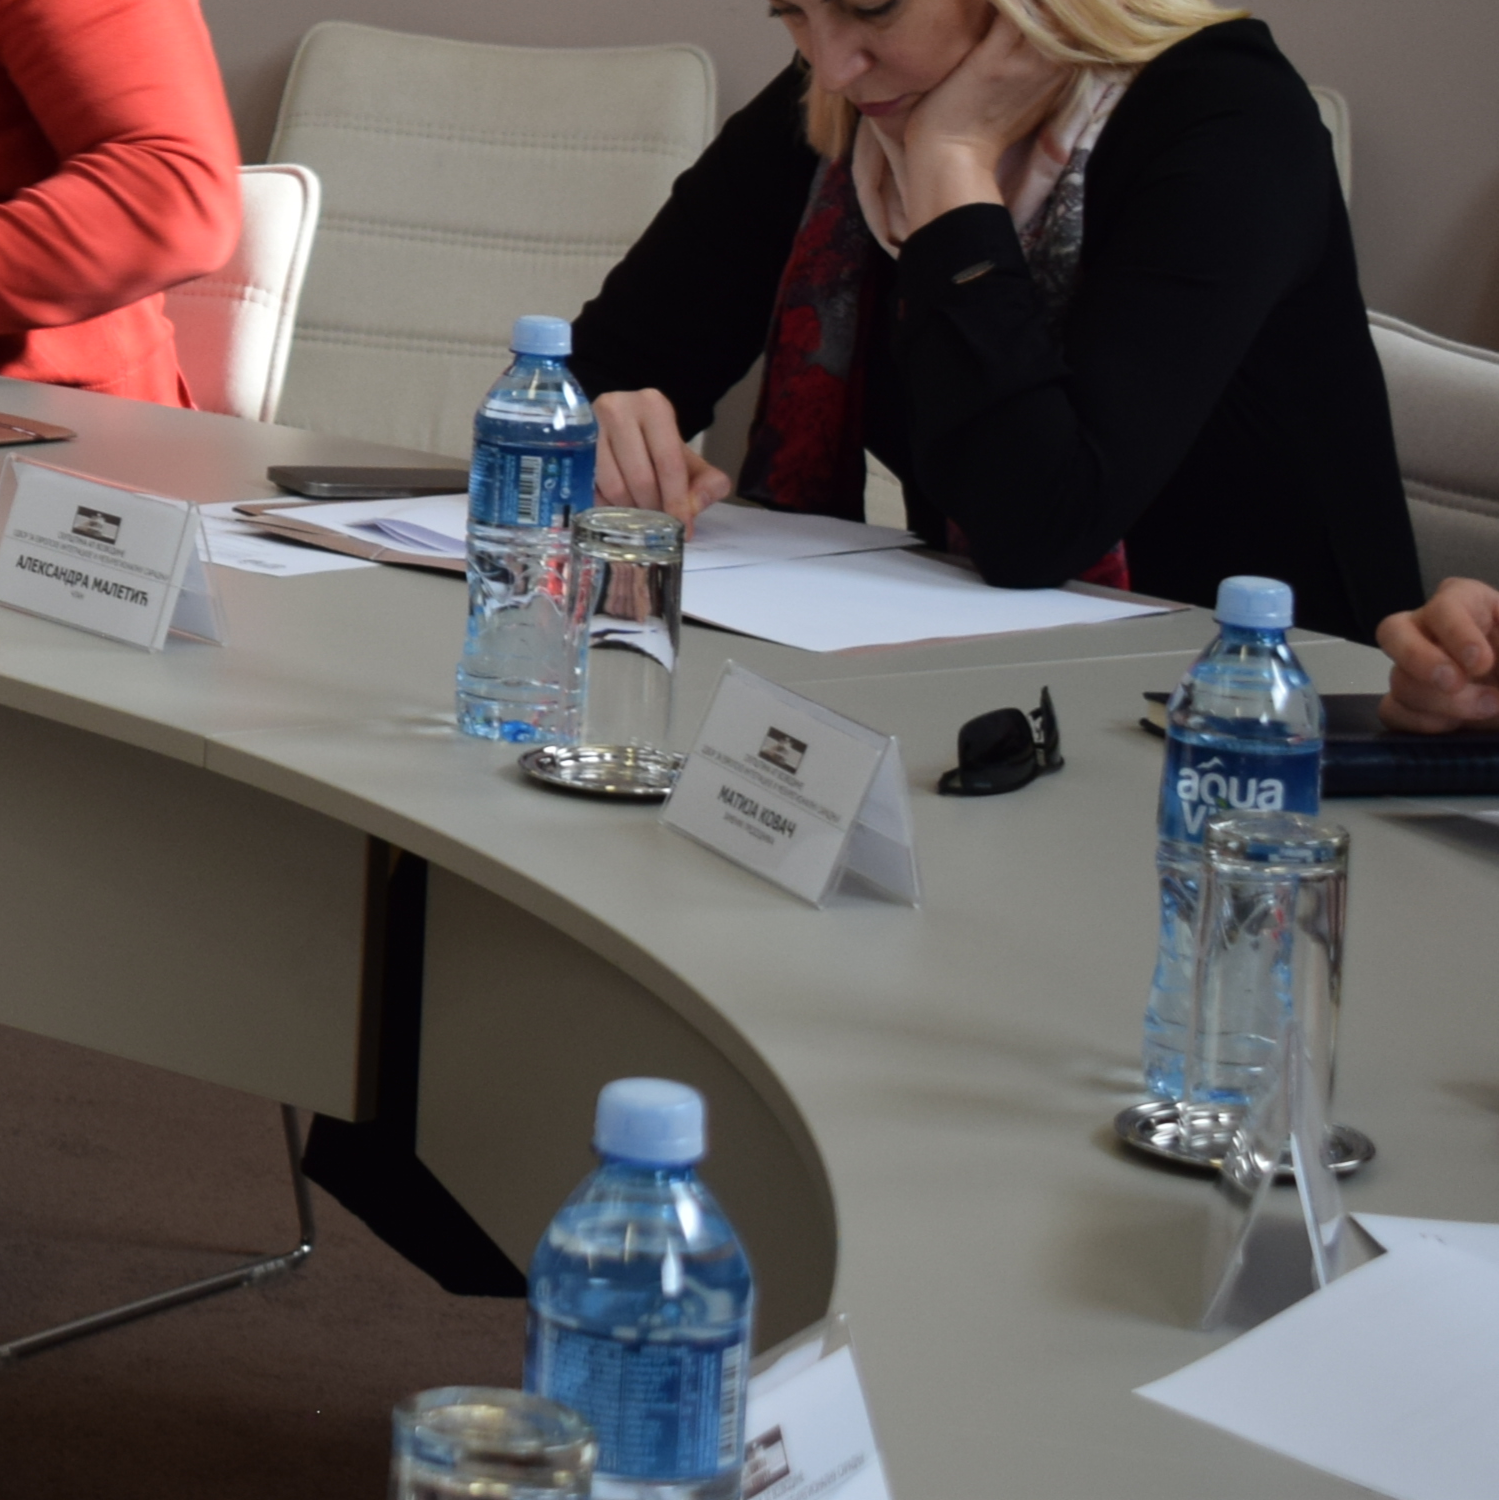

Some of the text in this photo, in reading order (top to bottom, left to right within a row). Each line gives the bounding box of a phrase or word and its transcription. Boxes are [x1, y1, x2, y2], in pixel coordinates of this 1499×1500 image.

[15, 554, 90, 590] АЛЕКСАНДРА
[91, 576, 149, 607] МАЛЕТИЋ
[759, 804, 797, 839] КОВАЧ
